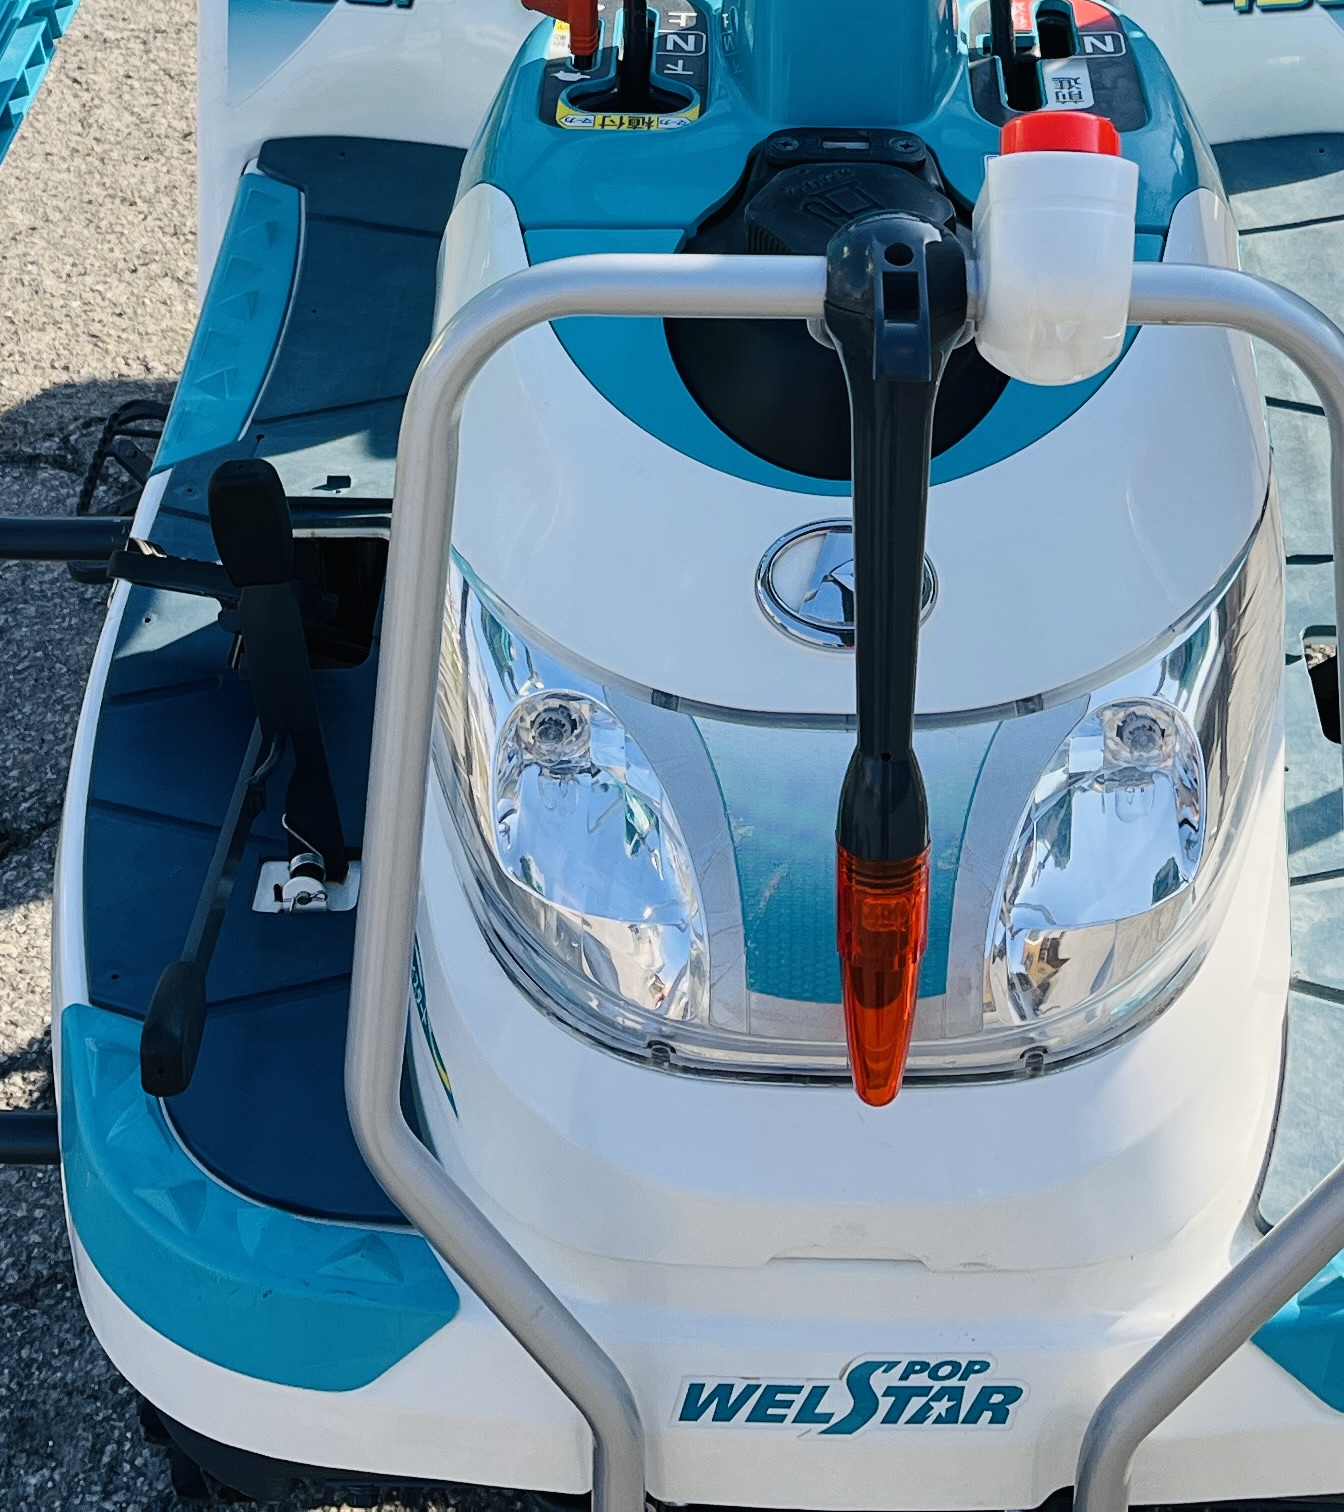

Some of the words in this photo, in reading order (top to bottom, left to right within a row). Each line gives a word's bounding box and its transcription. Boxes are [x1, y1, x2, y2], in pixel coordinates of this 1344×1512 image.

[666, 34, 695, 52] N
[1083, 35, 1115, 54] N
[1052, 76, 1085, 105] 前進
[599, 115, 655, 130] 植付
[898, 1360, 991, 1382] POP
[679, 1360, 1024, 1435] WELSTAR
